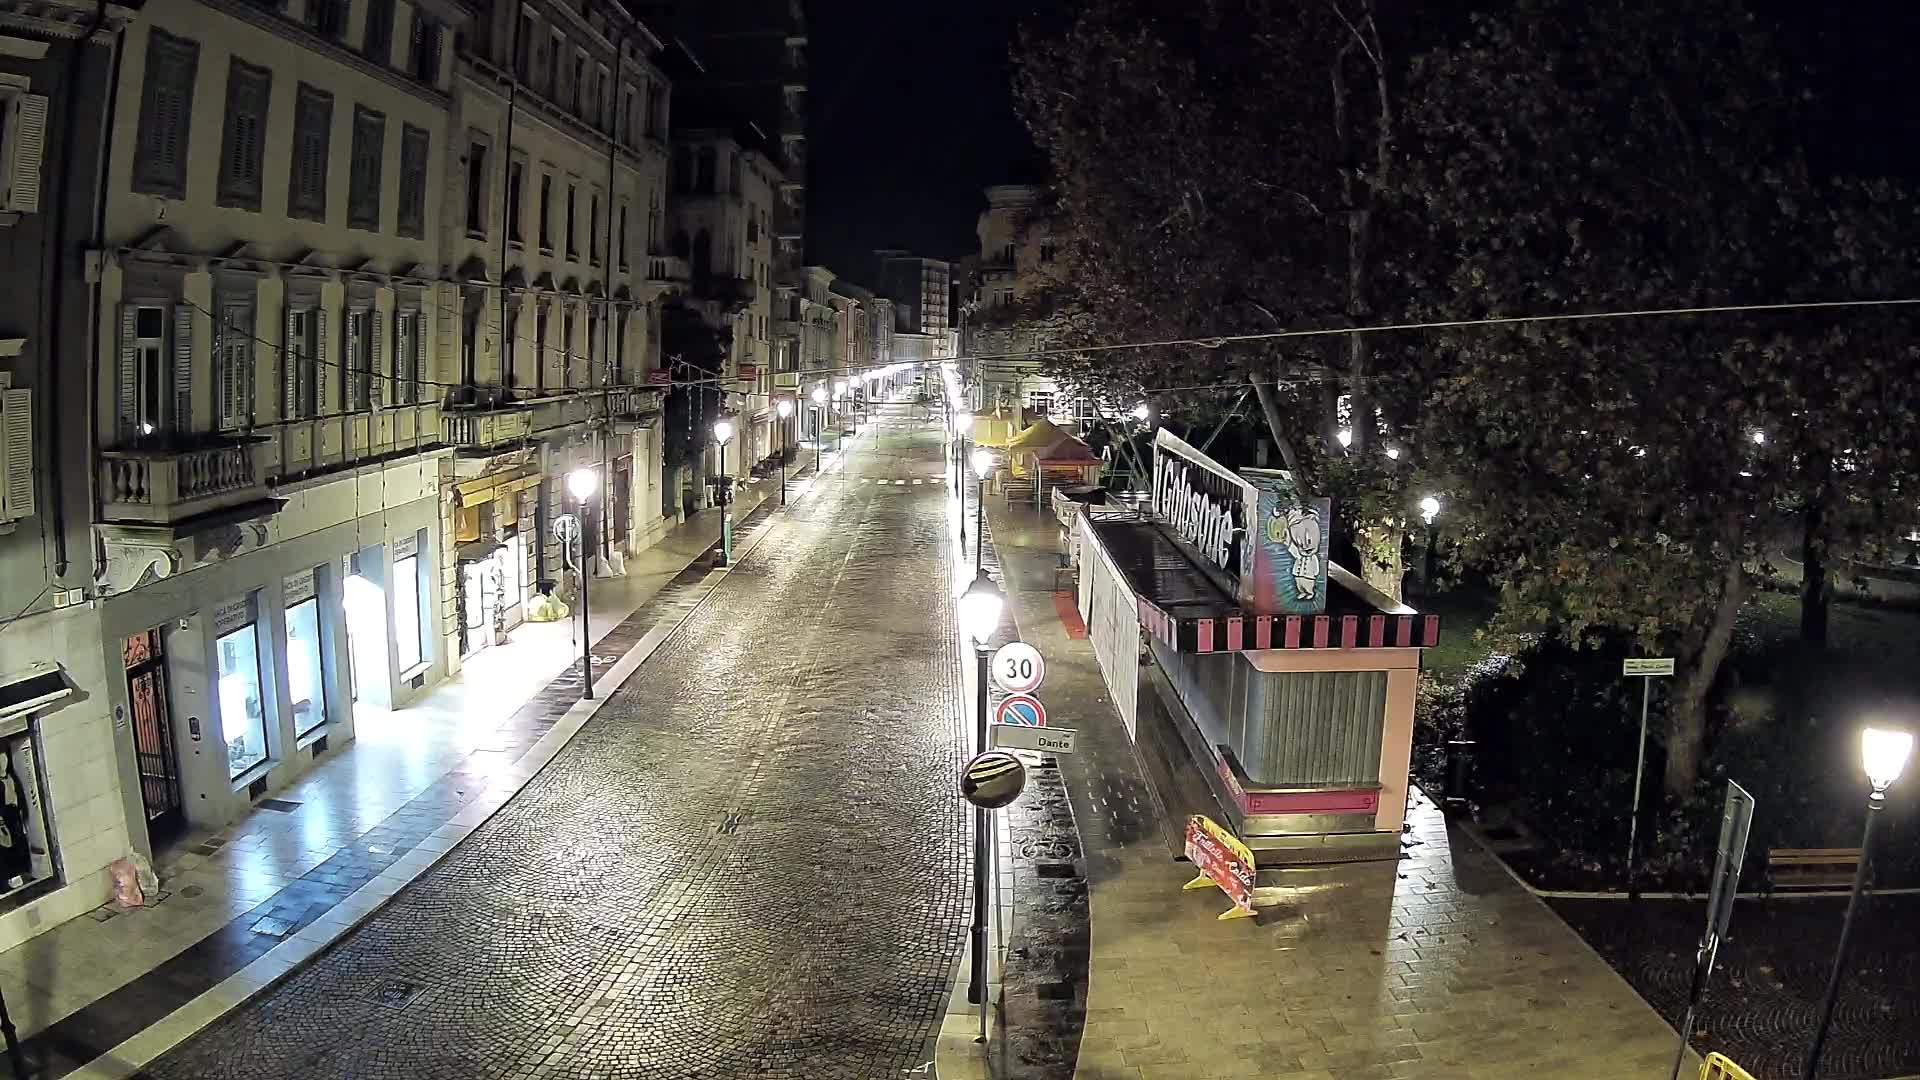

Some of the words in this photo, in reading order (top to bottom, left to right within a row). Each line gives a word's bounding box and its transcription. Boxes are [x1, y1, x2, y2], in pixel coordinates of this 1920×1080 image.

[1162, 458, 1233, 569] Golosone
[1006, 658, 1032, 679] 30
[1038, 737, 1070, 749] Dante
